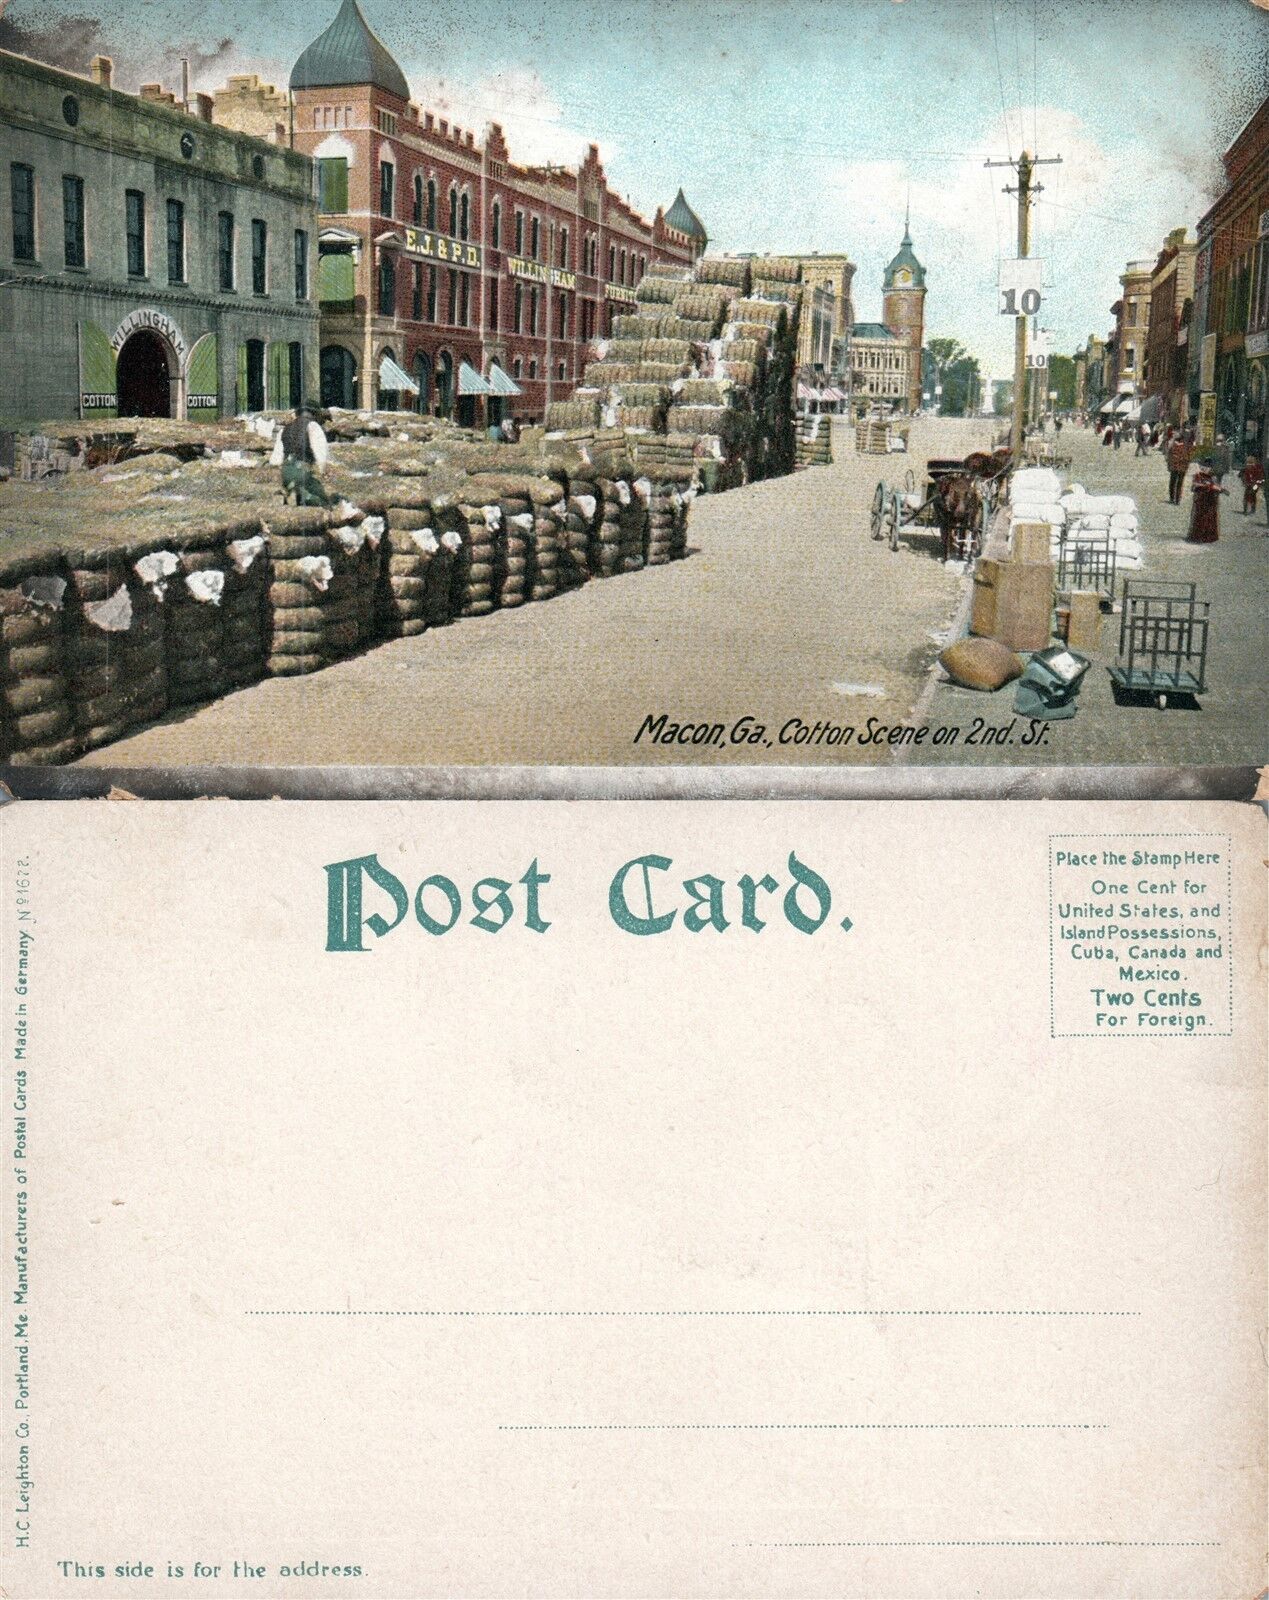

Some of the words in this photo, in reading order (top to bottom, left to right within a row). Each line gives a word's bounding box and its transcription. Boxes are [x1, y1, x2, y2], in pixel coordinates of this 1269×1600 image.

[438, 241, 448, 260] &
[507, 257, 576, 290] WILLINHAM
[1000, 288, 1041, 315] 10
[110, 311, 184, 355] WILLINGHAM
[1026, 354, 1046, 367] 10
[82, 395, 117, 407] COTTON
[187, 395, 217, 407] COTTON
[1056, 852, 1097, 865] Place
[1103, 851, 1127, 865] the
[1132, 851, 1181, 869] Stamp
[1185, 851, 1220, 864] Here
[1091, 880, 1129, 894] One
[1137, 880, 1177, 894] Cent
[1184, 880, 1207, 894] for
[322, 852, 552, 952] Post
[608, 849, 854, 936] Card.
[1058, 903, 1114, 918] United
[1119, 903, 1184, 919] States,
[1190, 904, 1221, 918] and
[1061, 925, 1105, 939] Island
[1108, 924, 1222, 941] Possessions,
[1071, 944, 1119, 962] Cuba,
[1128, 945, 1186, 959] Canada
[1195, 945, 1223, 959] and
[14, 930, 34, 995] Germany
[1119, 964, 1188, 981] Mexico.
[1090, 989, 1134, 1006] Two
[1144, 989, 1202, 1007] Cents
[15, 1004, 27, 1016] in
[1096, 1013, 1128, 1027] For
[1138, 1012, 1213, 1031] Foreign.
[14, 1020, 27, 1060] Made
[14, 1070, 27, 1111] Cards
[14, 1117, 26, 1159] Postal
[14, 1167, 27, 1184] of
[13, 1191, 28, 1305] Manufacturers
[15, 1340, 29, 1409] Portland,
[15, 1445, 34, 1512] Leighton
[57, 1560, 106, 1578] This
[114, 1560, 154, 1578] side
[167, 1560, 185, 1578] is
[194, 1561, 221, 1578] for
[233, 1560, 267, 1578] the
[279, 1560, 369, 1578] address.
